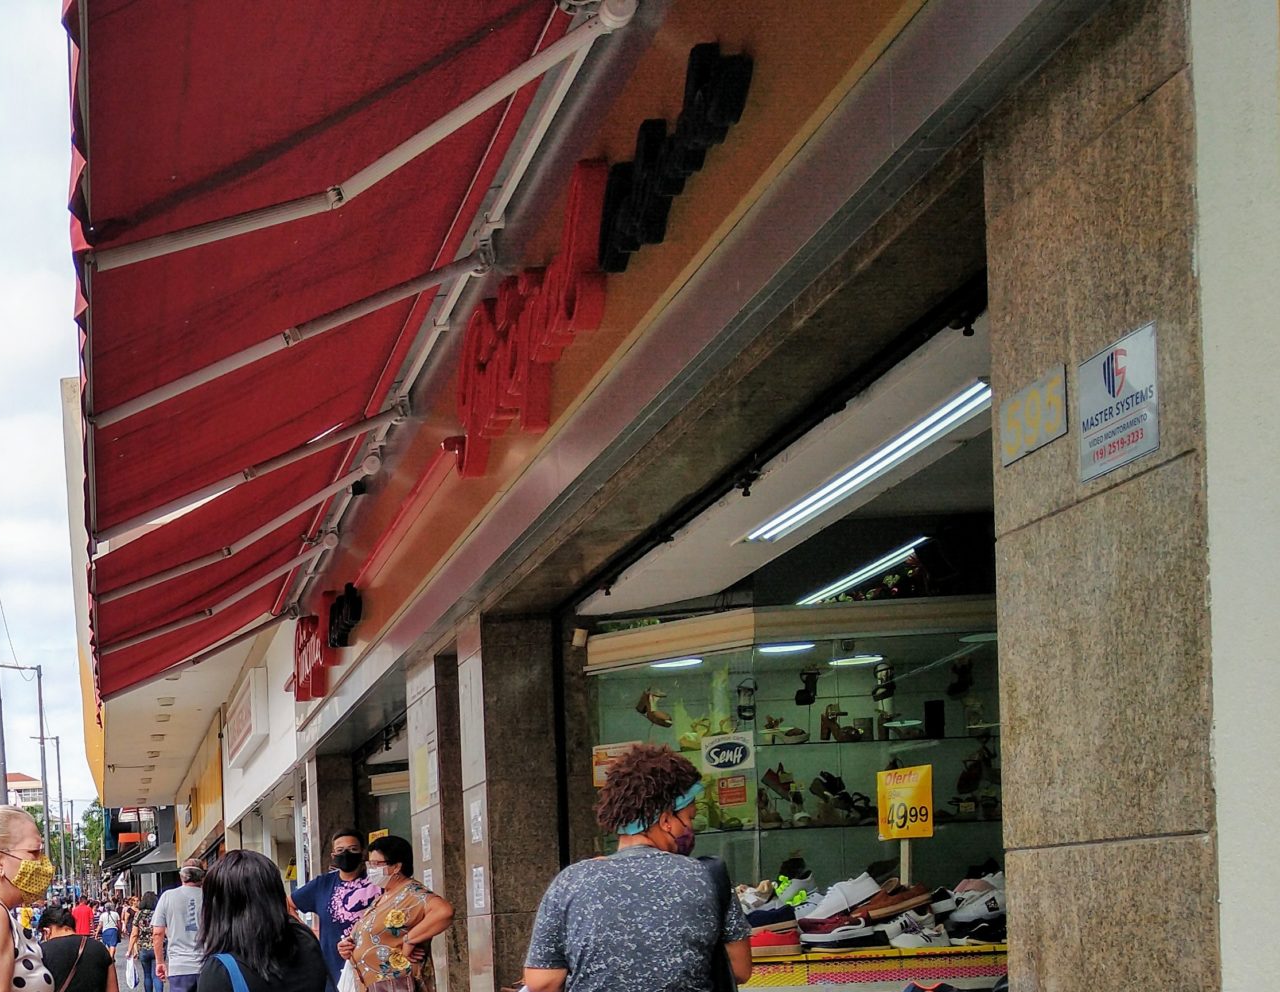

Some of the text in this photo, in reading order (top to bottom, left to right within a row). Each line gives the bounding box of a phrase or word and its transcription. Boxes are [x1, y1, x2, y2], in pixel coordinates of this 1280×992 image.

[1004, 374, 1062, 458] 595
[1082, 384, 1154, 434] MASTER SYSTEMS
[1104, 412, 1148, 440] MONITORAMENTO
[1092, 445, 1107, 463] (19)
[709, 746, 745, 766] Senff
[885, 770, 920, 786] Oferta
[887, 802, 929, 831] 49,99
